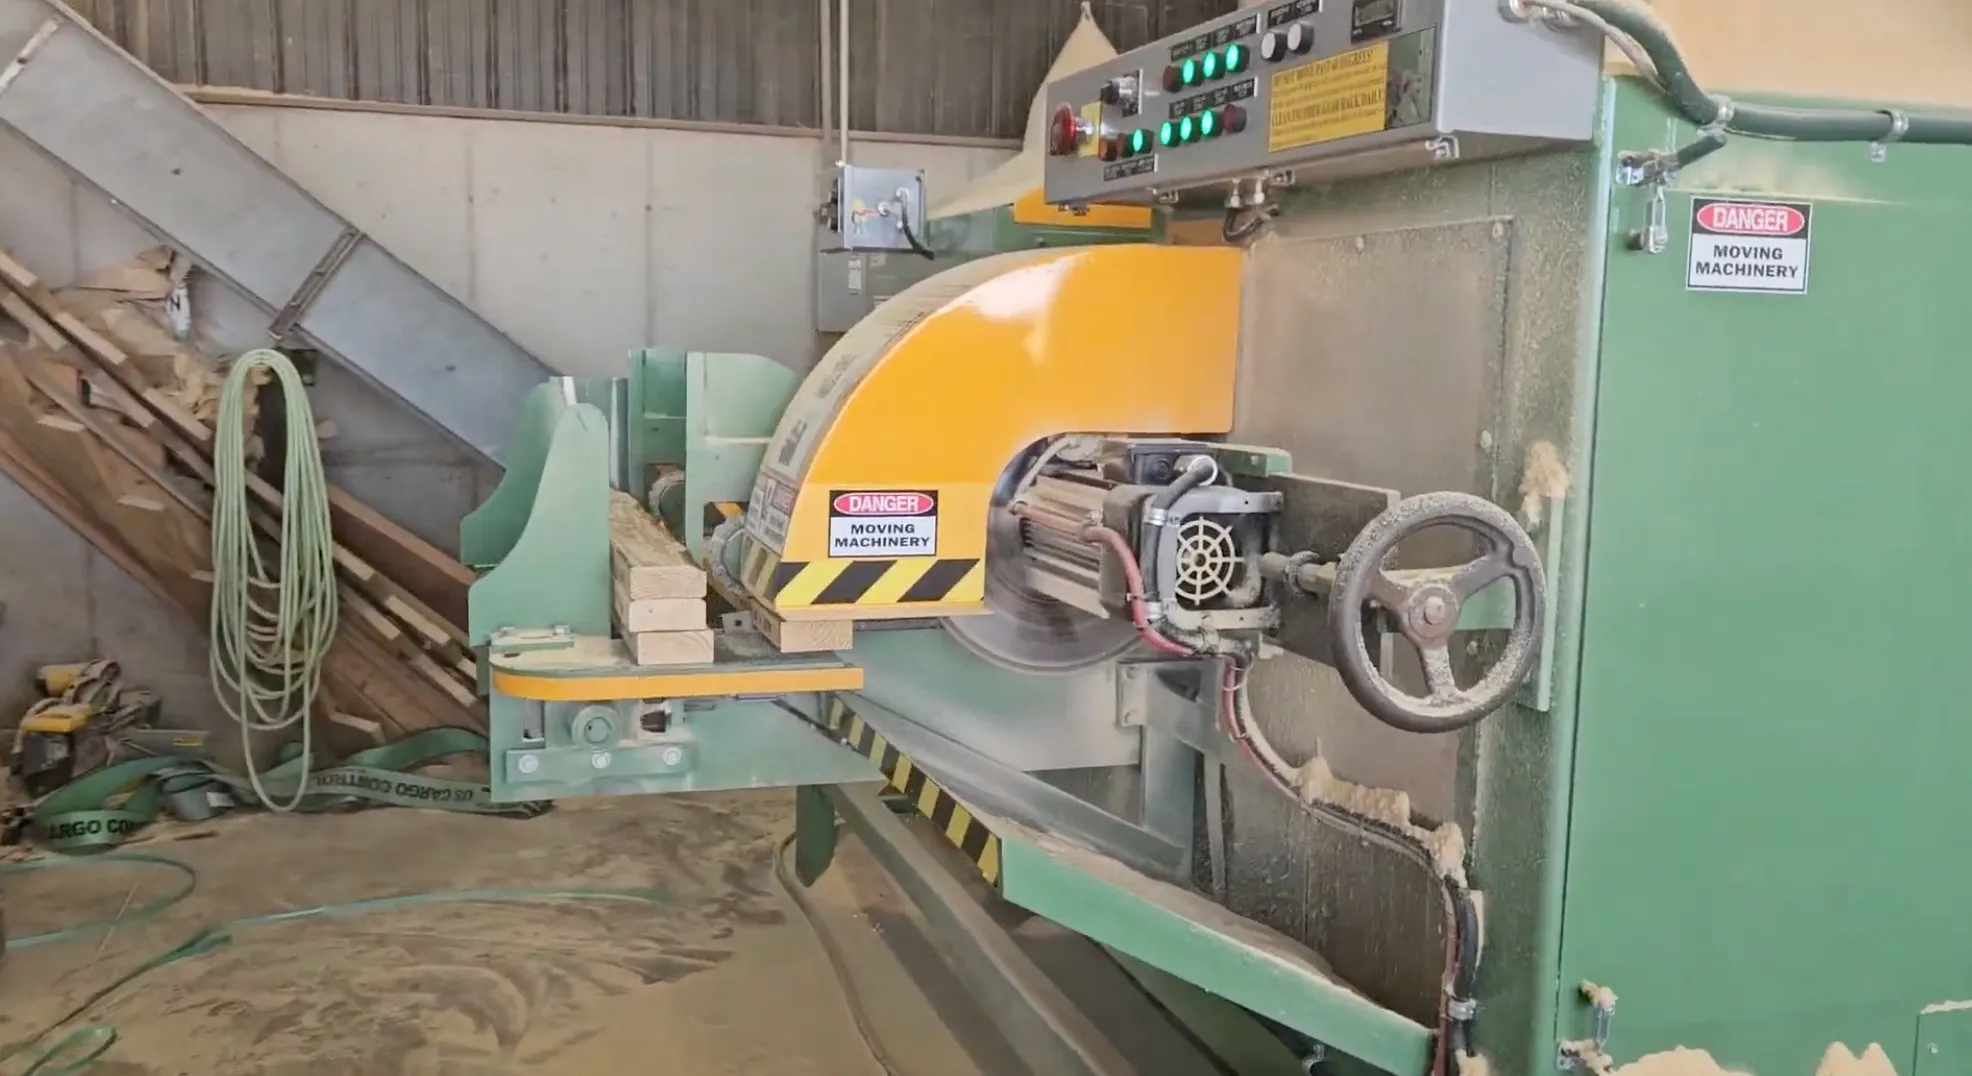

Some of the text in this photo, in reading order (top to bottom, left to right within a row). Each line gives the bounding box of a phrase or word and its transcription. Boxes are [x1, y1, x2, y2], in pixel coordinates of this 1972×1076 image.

[1712, 206, 1789, 232] DANGER
[1713, 244, 1783, 260] MOVING
[1695, 261, 1799, 279] MACHINERY
[848, 494, 920, 513] DANGER
[850, 524, 916, 535] MOVING
[834, 537, 930, 548] MACHINERY
[396, 782, 451, 801] CARGO
